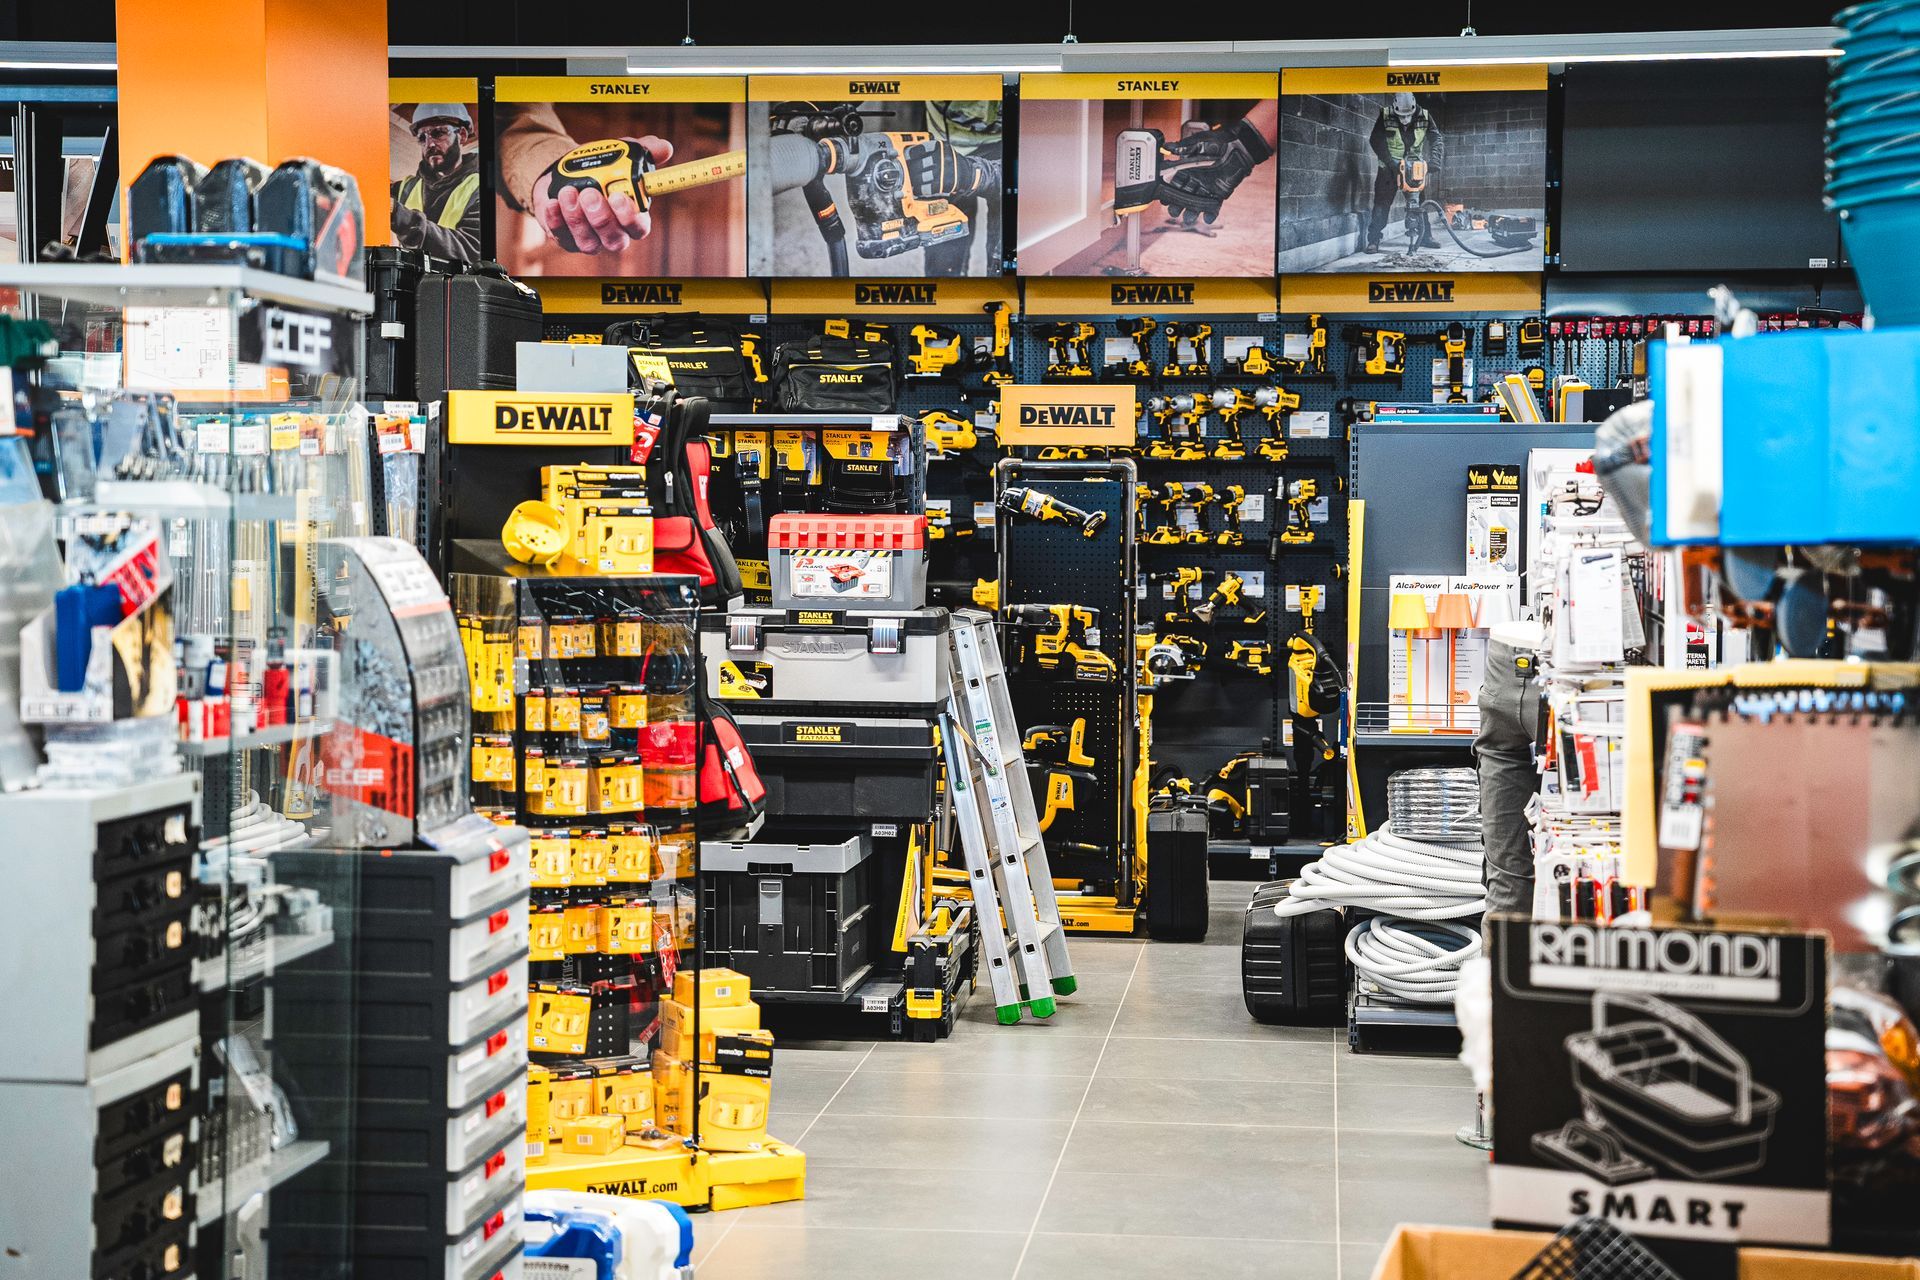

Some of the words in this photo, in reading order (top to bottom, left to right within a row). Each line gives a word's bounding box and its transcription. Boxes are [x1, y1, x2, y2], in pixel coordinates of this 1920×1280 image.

[1387, 73, 1440, 85] DEWALT
[590, 84, 650, 95] STANLEY
[849, 82, 901, 94] DEWALT
[1117, 81, 1179, 92] STANLEY
[572, 143, 620, 156] STANLEY
[602, 285, 682, 305] DEWALT
[855, 285, 936, 305] DEWALT
[1111, 285, 1194, 305] DEWALT
[1369, 281, 1453, 302] DEWALT
[668, 361, 708, 370] STANLEY
[819, 374, 863, 384] STANLEY
[495, 405, 612, 431] DEWALT
[1020, 405, 1115, 426] DEWALT
[847, 464, 878, 472] STANLEY
[1469, 470, 1488, 485] VIGOR
[1492, 469, 1518, 485] VIGOR
[798, 611, 833, 619] STANLEY
[782, 640, 849, 655] STANLEY
[796, 726, 841, 735] STANLEY
[1061, 918, 1089, 928] ALT.com
[1531, 925, 1781, 978] RAIMONDI
[1570, 1188, 1746, 1229] SMART
